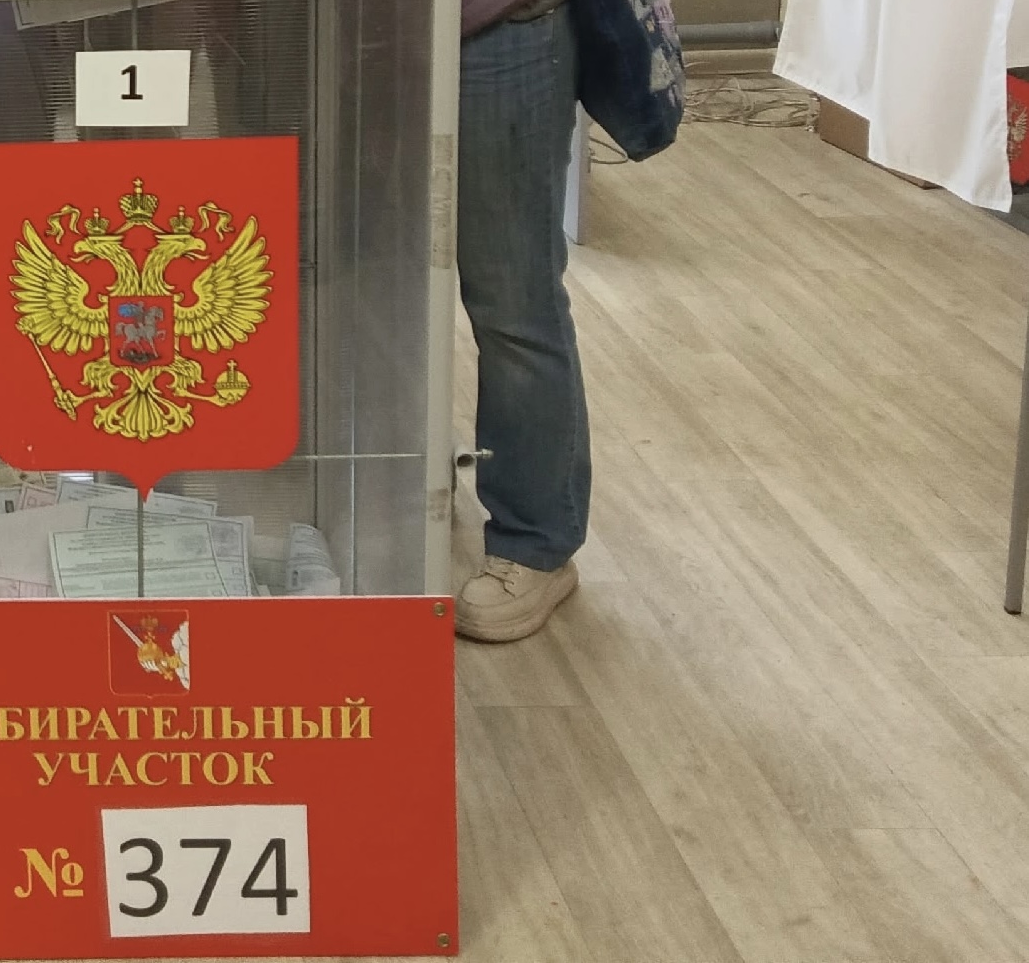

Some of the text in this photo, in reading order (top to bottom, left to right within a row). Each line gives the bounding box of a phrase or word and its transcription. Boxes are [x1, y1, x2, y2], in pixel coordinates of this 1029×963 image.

[121, 64, 144, 100] 1
[33, 751, 275, 787] УЧАСТОК
[13, 836, 300, 918] № 374
